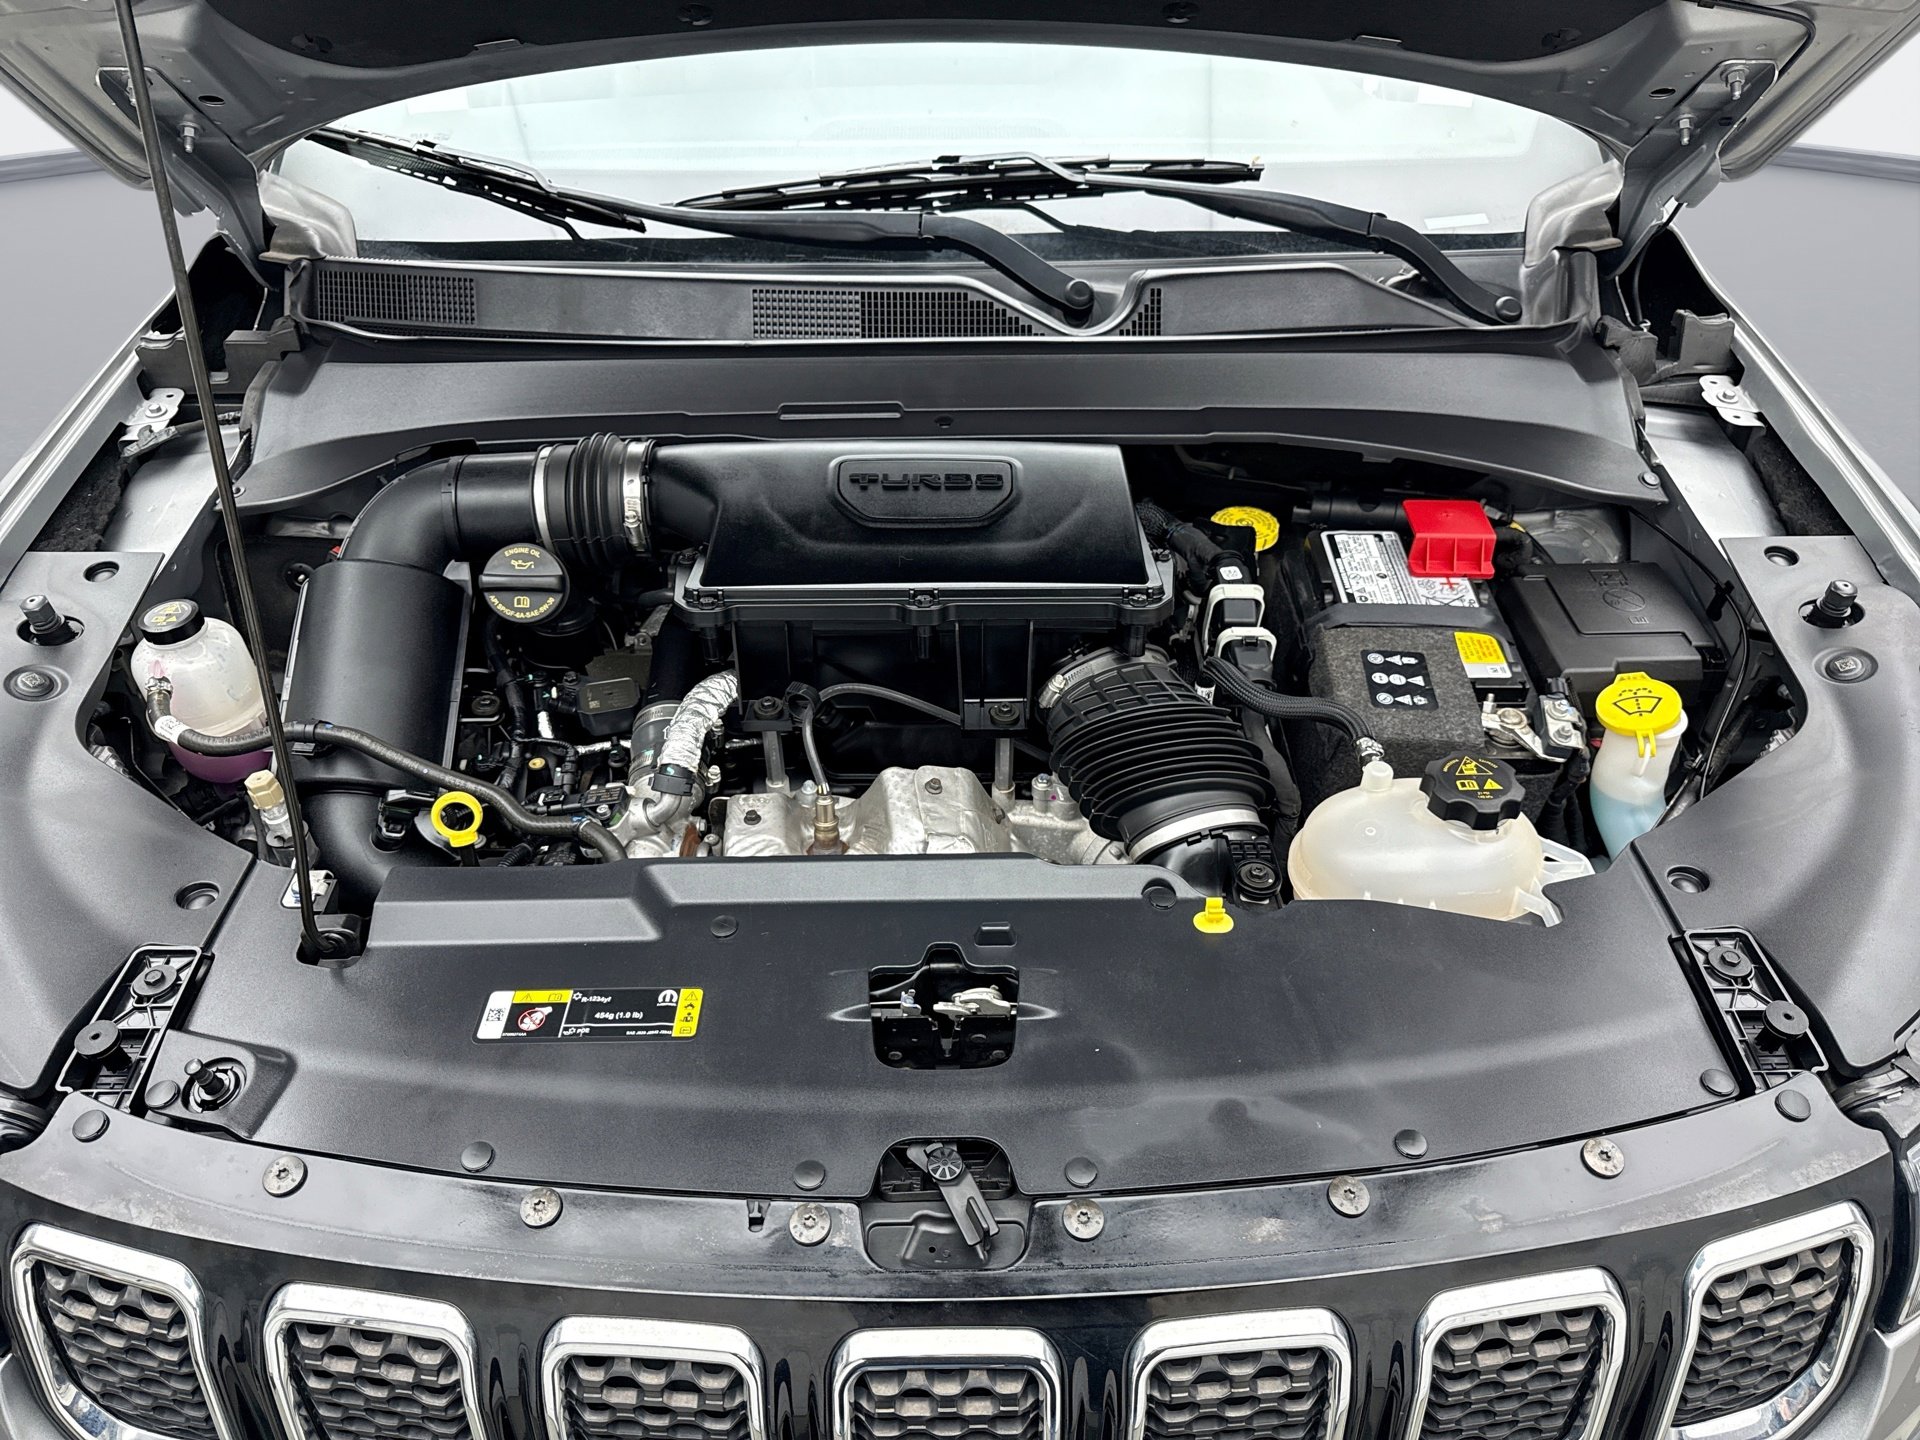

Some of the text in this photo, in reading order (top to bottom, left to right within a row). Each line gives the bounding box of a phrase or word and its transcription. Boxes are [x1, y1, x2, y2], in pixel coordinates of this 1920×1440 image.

[849, 473, 1004, 490] TURBO
[504, 548, 541, 558] ENGINE OIL
[489, 595, 499, 606] API
[581, 996, 612, 1004] R-1234yf
[594, 1011, 643, 1020] 454g (1.0 lb)
